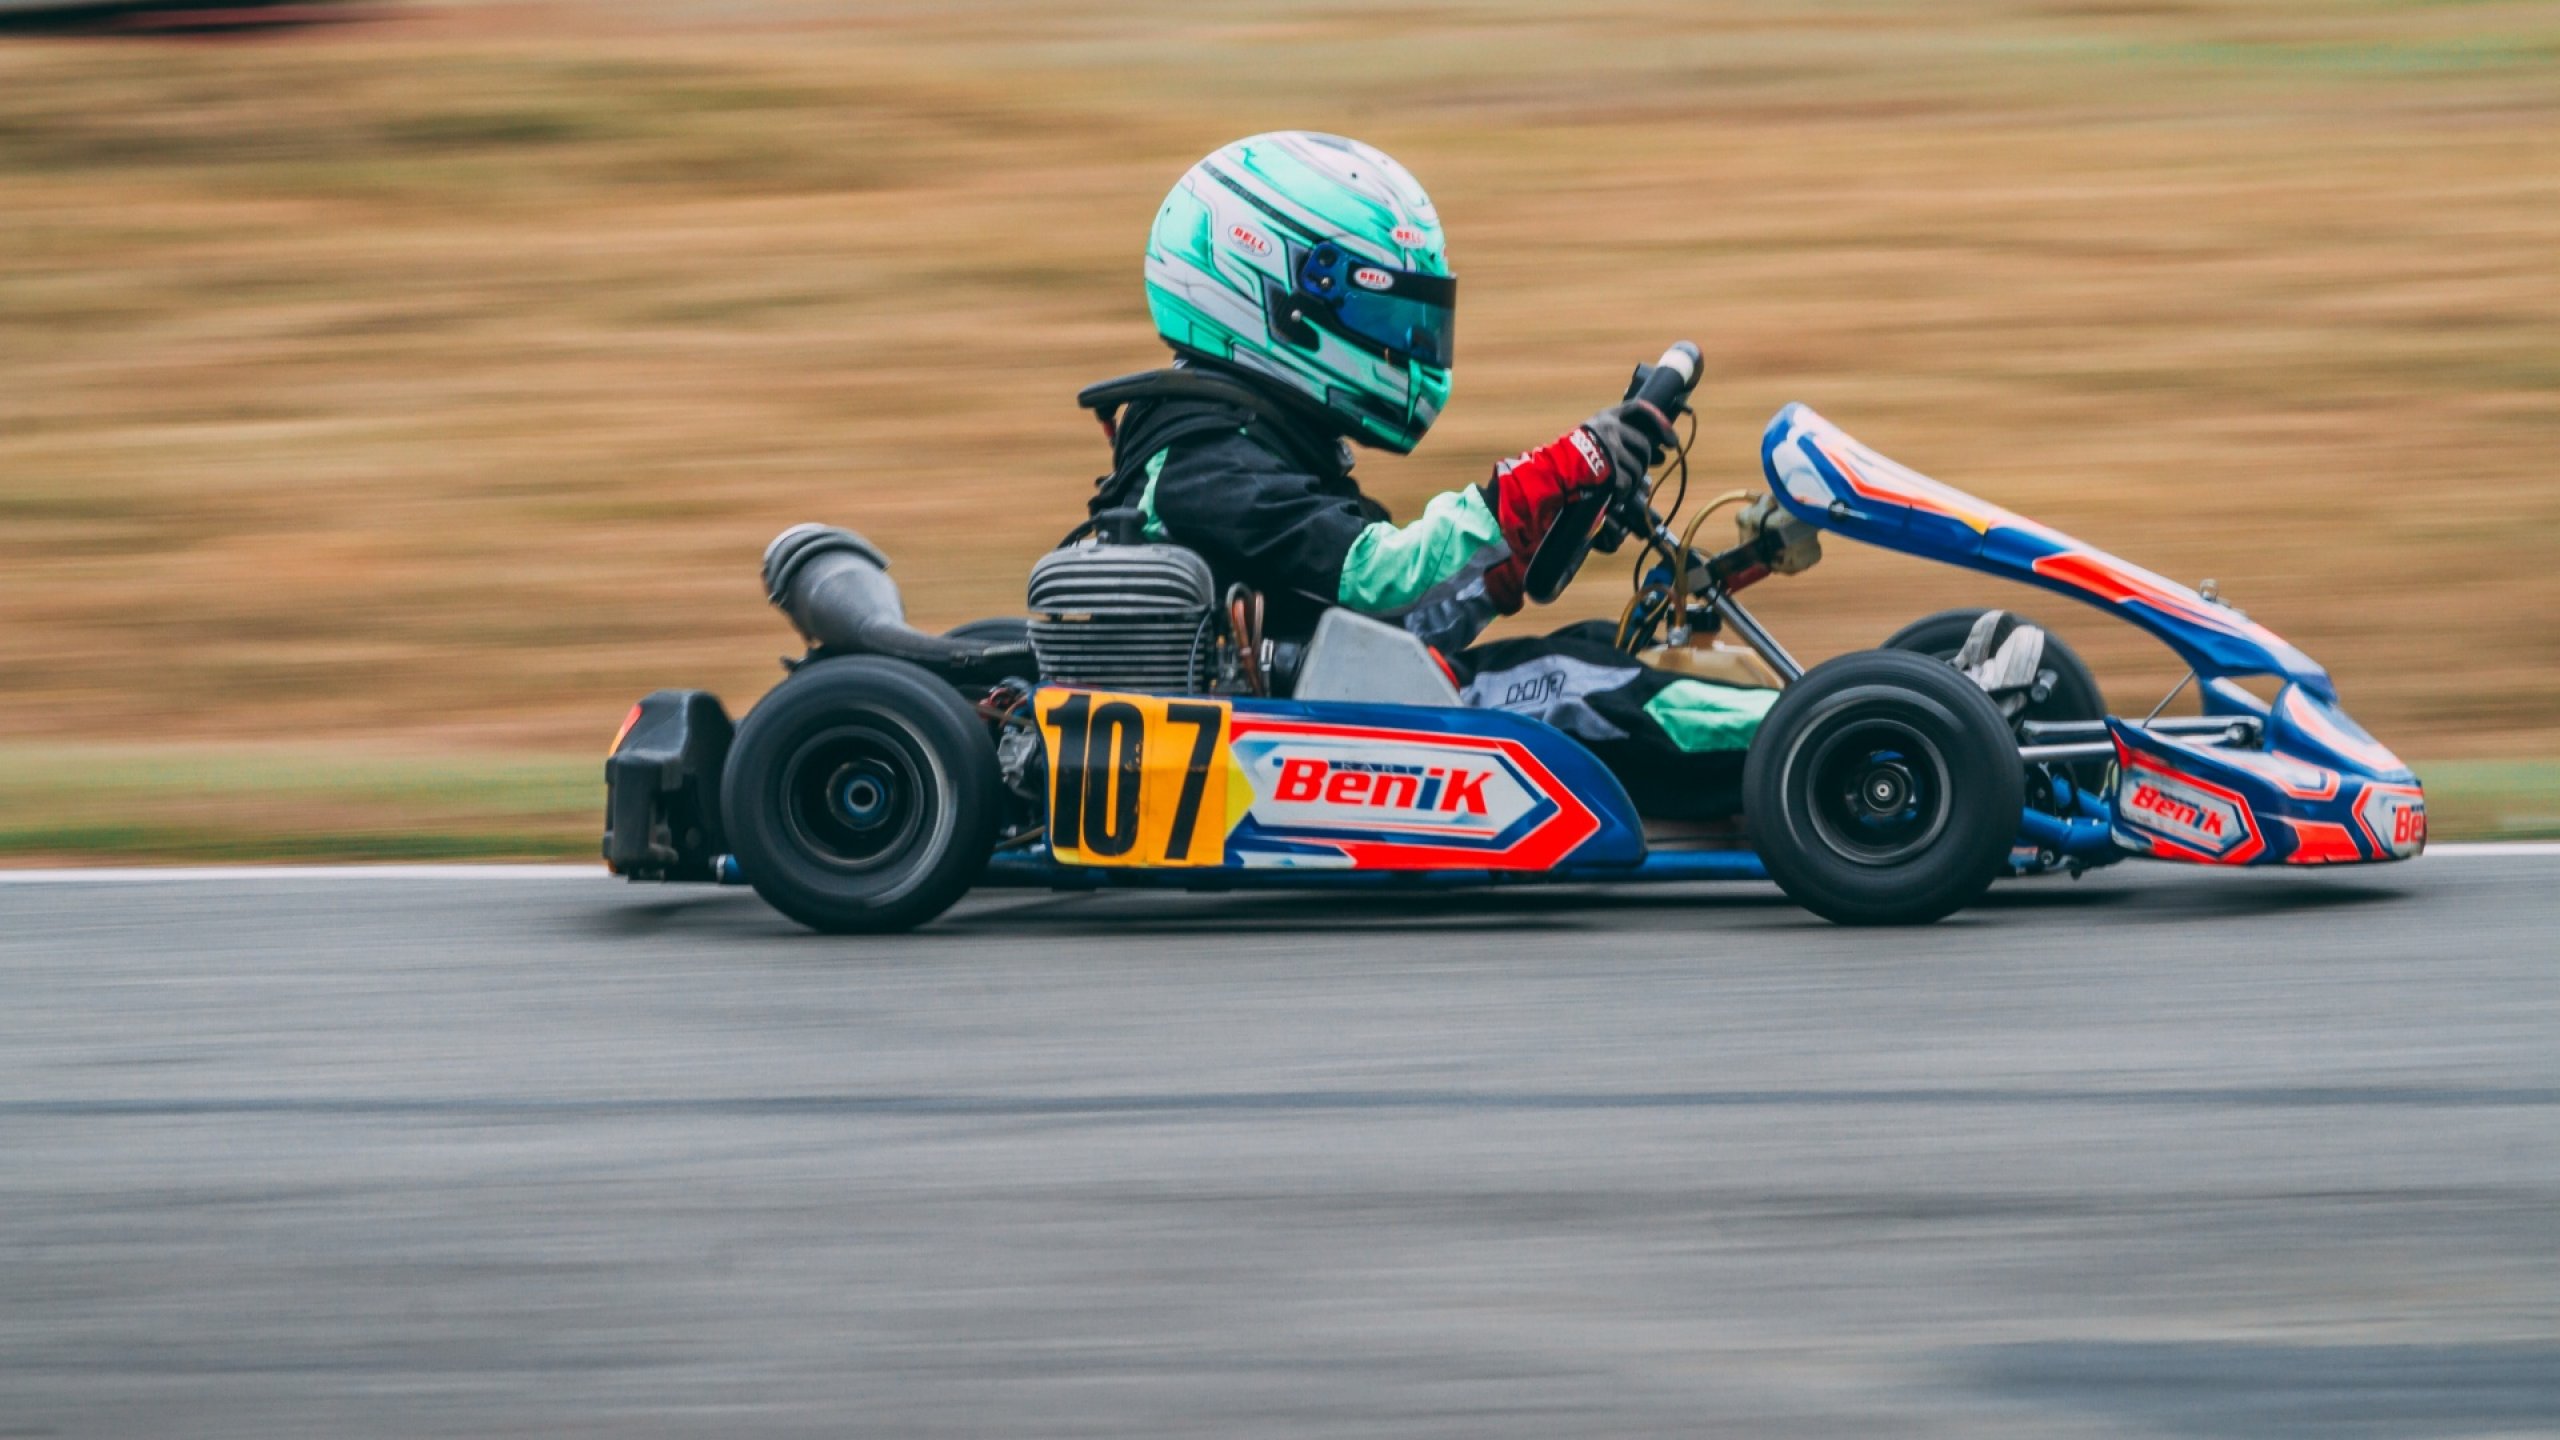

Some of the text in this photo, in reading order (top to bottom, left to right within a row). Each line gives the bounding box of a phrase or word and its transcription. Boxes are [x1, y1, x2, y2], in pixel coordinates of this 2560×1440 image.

[1233, 226, 1265, 251] BELL
[1396, 229, 1423, 244] BELL
[1360, 271, 1388, 285] BELL
[1046, 694, 1222, 860] 107
[2394, 804, 2426, 844] Be
